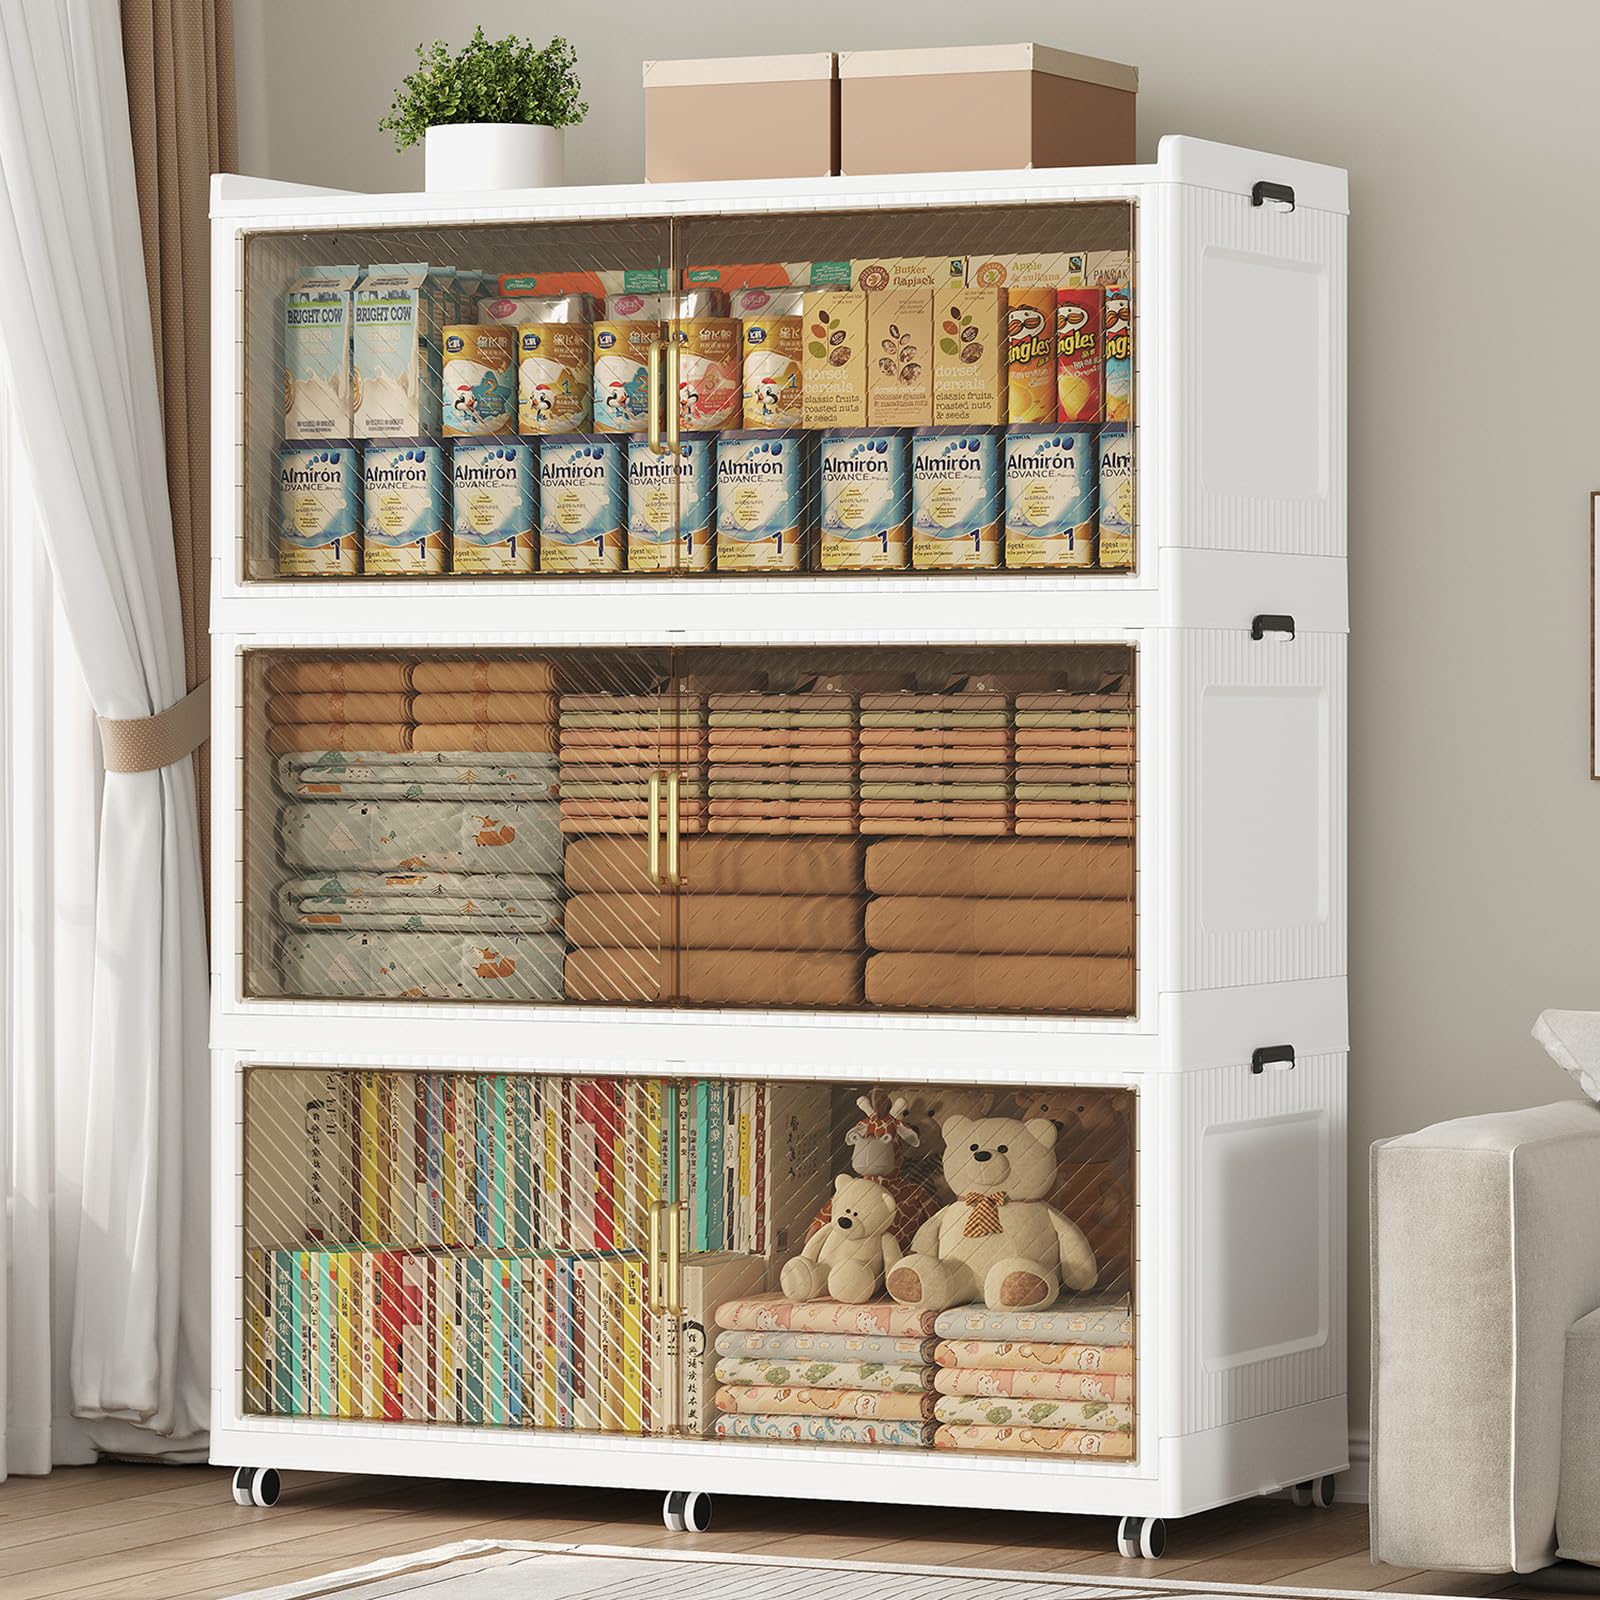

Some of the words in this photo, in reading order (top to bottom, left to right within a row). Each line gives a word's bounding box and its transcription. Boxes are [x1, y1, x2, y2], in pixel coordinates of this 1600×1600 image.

[894, 265, 927, 274] Butter
[1011, 261, 1042, 272] Apple
[893, 275, 935, 287] flapjack
[287, 309, 321, 325] BRIGHT
[322, 308, 343, 323] COW
[356, 307, 389, 322] BRIGHT
[390, 306, 412, 321] COW
[805, 368, 848, 380] dorset
[936, 365, 979, 377] dorset
[484, 379, 497, 396] 2
[561, 380, 572, 395] 1
[787, 373, 798, 389] 1
[804, 380, 853, 394] cereals
[935, 377, 985, 390] cereals
[805, 394, 834, 403] classic
[835, 394, 863, 404] fruits,
[936, 392, 965, 401] classic
[967, 391, 994, 401] fruits,
[804, 404, 838, 414] roasted
[839, 404, 860, 413] nuts
[936, 402, 968, 410] roasted
[971, 401, 992, 410] nuts
[804, 414, 812, 422] &
[814, 414, 838, 422] seeds
[936, 411, 944, 420] &
[945, 411, 970, 419] seeds
[719, 459, 783, 475] Almirón
[823, 456, 888, 473] Almirón
[915, 455, 981, 471] Almirón
[1008, 453, 1075, 469] Almirón
[281, 467, 341, 484] Almirón
[366, 466, 426, 482] Almirón
[455, 464, 517, 481] Almirón
[542, 463, 604, 479] Almirón
[823, 473, 869, 481] ADVANCE
[914, 471, 961, 480] ADVANCE
[1008, 470, 1054, 479] ADVANCE
[366, 482, 407, 490] ADVANCE
[455, 480, 498, 488] ADVANCE
[542, 479, 585, 487] ADVANCE
[719, 475, 763, 483] ADVANCE
[281, 483, 322, 492] ADVANCE
[507, 536, 516, 558] 1
[594, 534, 604, 557] 1
[683, 532, 692, 555] 1
[772, 531, 782, 554] 1
[878, 530, 888, 553] 1
[970, 529, 980, 552] 1
[1064, 528, 1074, 551] 1
[331, 538, 341, 561] 1
[416, 537, 426, 560] 1
